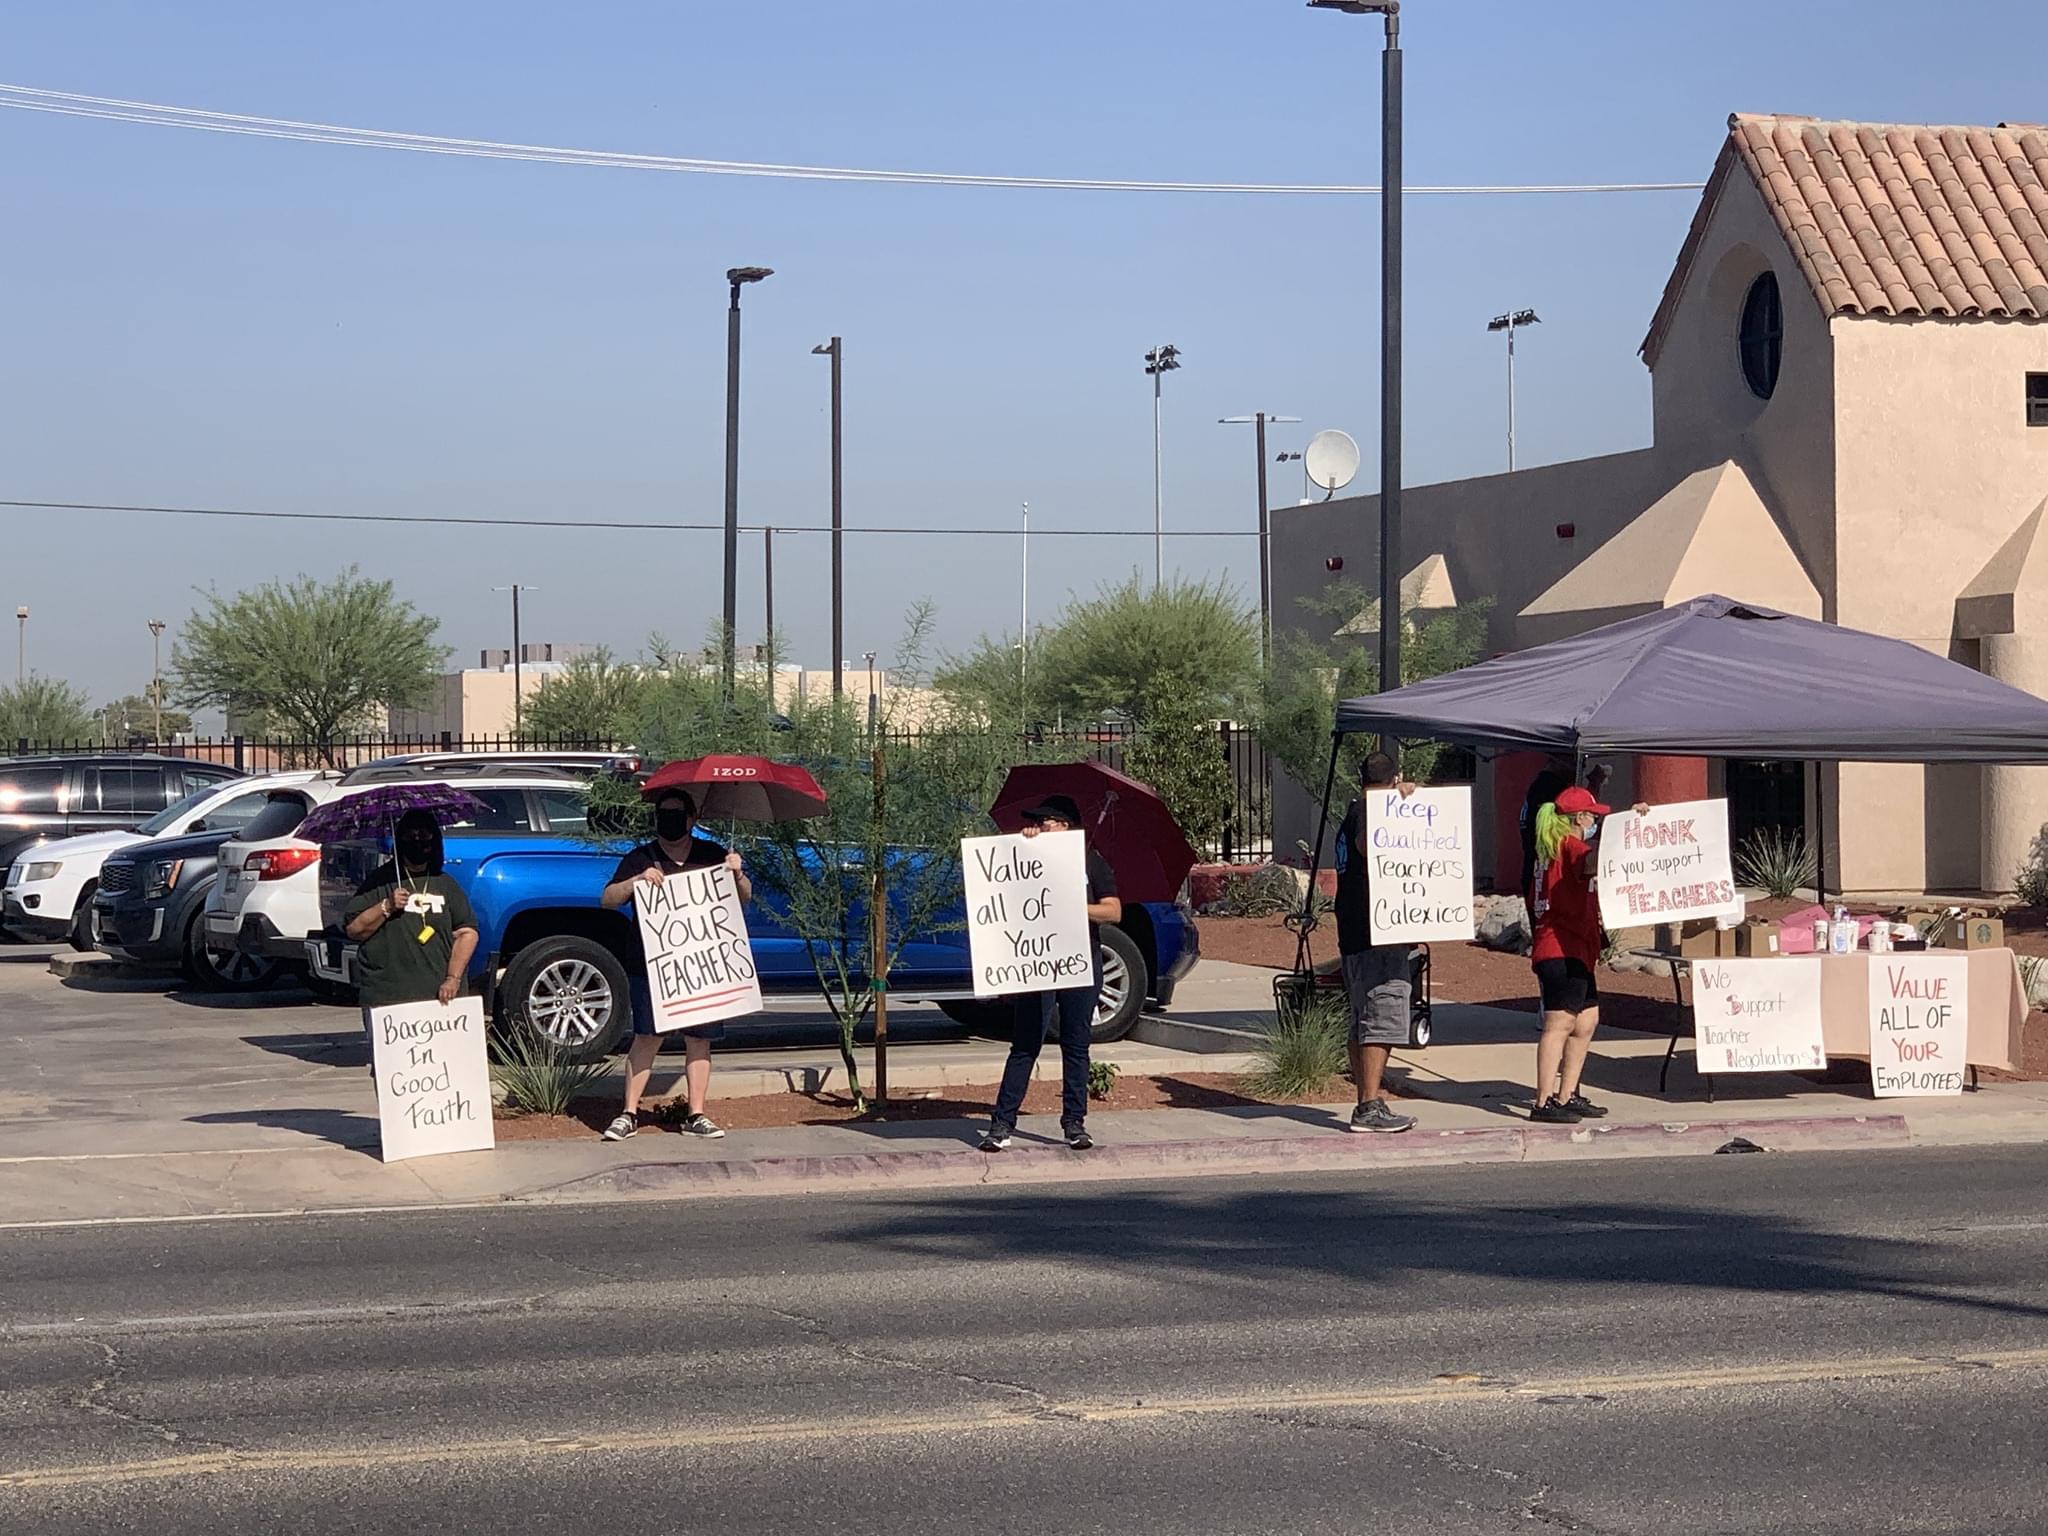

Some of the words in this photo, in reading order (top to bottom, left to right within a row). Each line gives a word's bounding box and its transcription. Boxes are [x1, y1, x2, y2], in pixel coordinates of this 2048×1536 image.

[712, 767, 757, 777] IZOD
[1386, 794, 1439, 827] Keep
[1373, 825, 1461, 851] Qualified
[1623, 817, 1698, 850] HONK
[975, 846, 1044, 883] Value
[1374, 854, 1465, 880] Teachers
[1621, 861, 1645, 883] you
[1650, 845, 1704, 876] support
[636, 866, 732, 915] VALUE
[1402, 881, 1426, 897] in
[1615, 879, 1735, 916] TEACHERS
[976, 893, 1008, 926] all
[1374, 898, 1469, 931] Calexico
[645, 905, 737, 952] YOUR
[648, 938, 754, 1001] TEACHERS
[985, 953, 1089, 987] employees
[1699, 965, 1732, 990] We
[1887, 965, 1948, 1000] VALUE
[1725, 991, 1786, 1017] Support
[1879, 1005, 1920, 1031] ALL
[1926, 1005, 1952, 1029] OF
[383, 1014, 468, 1046] Bargain
[1700, 1025, 1751, 1045] Teacher
[407, 1044, 435, 1068] In
[1891, 1037, 1943, 1062] YOUR
[390, 1061, 451, 1097] Good
[405, 1091, 476, 1129] Faith
